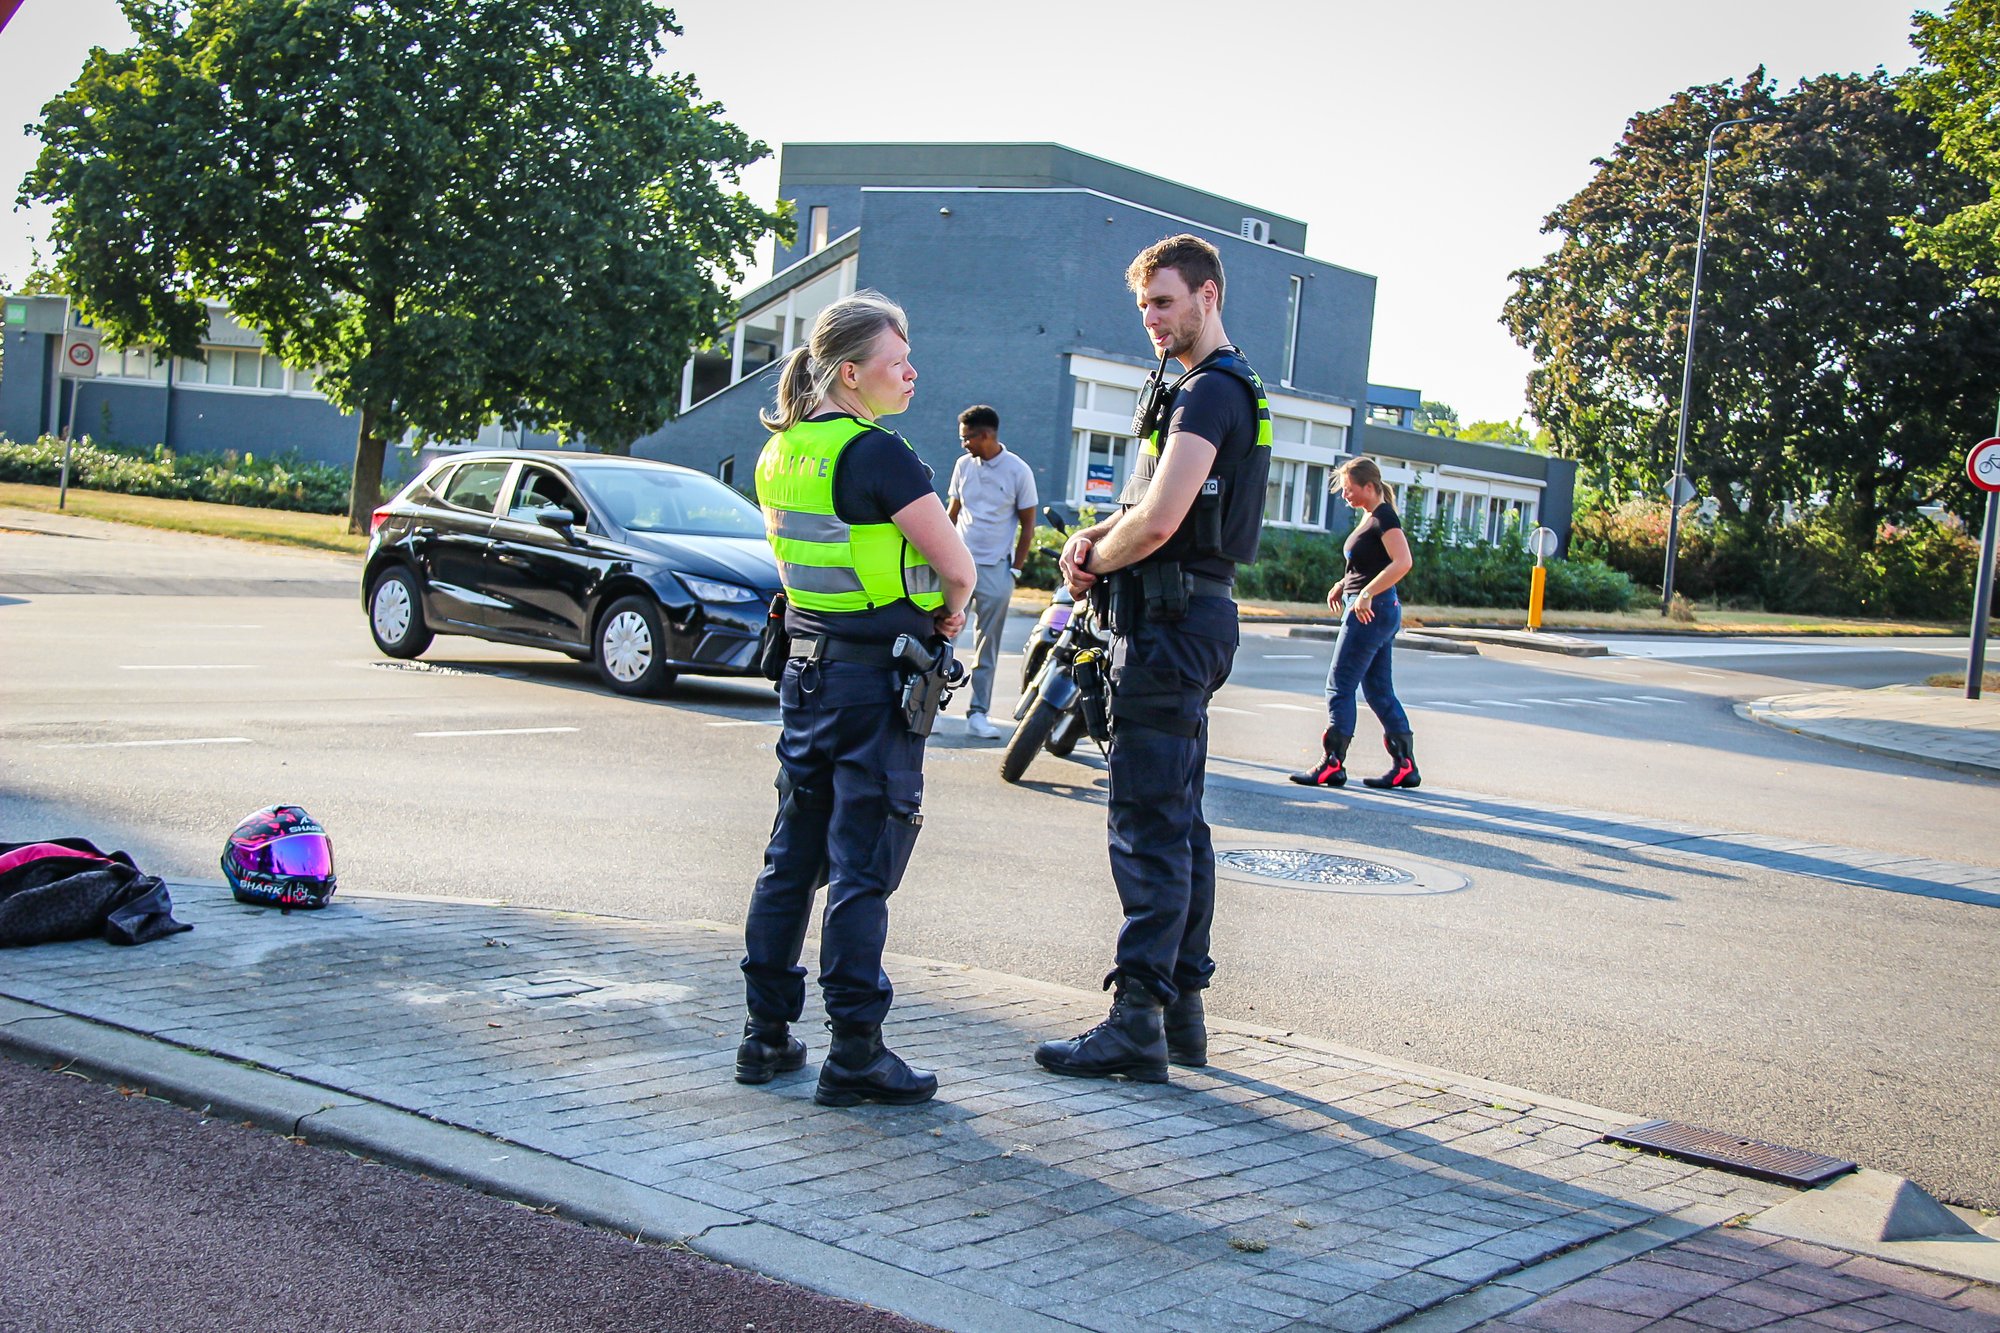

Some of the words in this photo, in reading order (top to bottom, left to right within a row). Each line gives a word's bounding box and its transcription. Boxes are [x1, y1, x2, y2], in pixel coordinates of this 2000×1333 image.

[74, 349, 90, 360] 30
[289, 825, 322, 833] SHARK
[239, 879, 283, 895] SHARK
